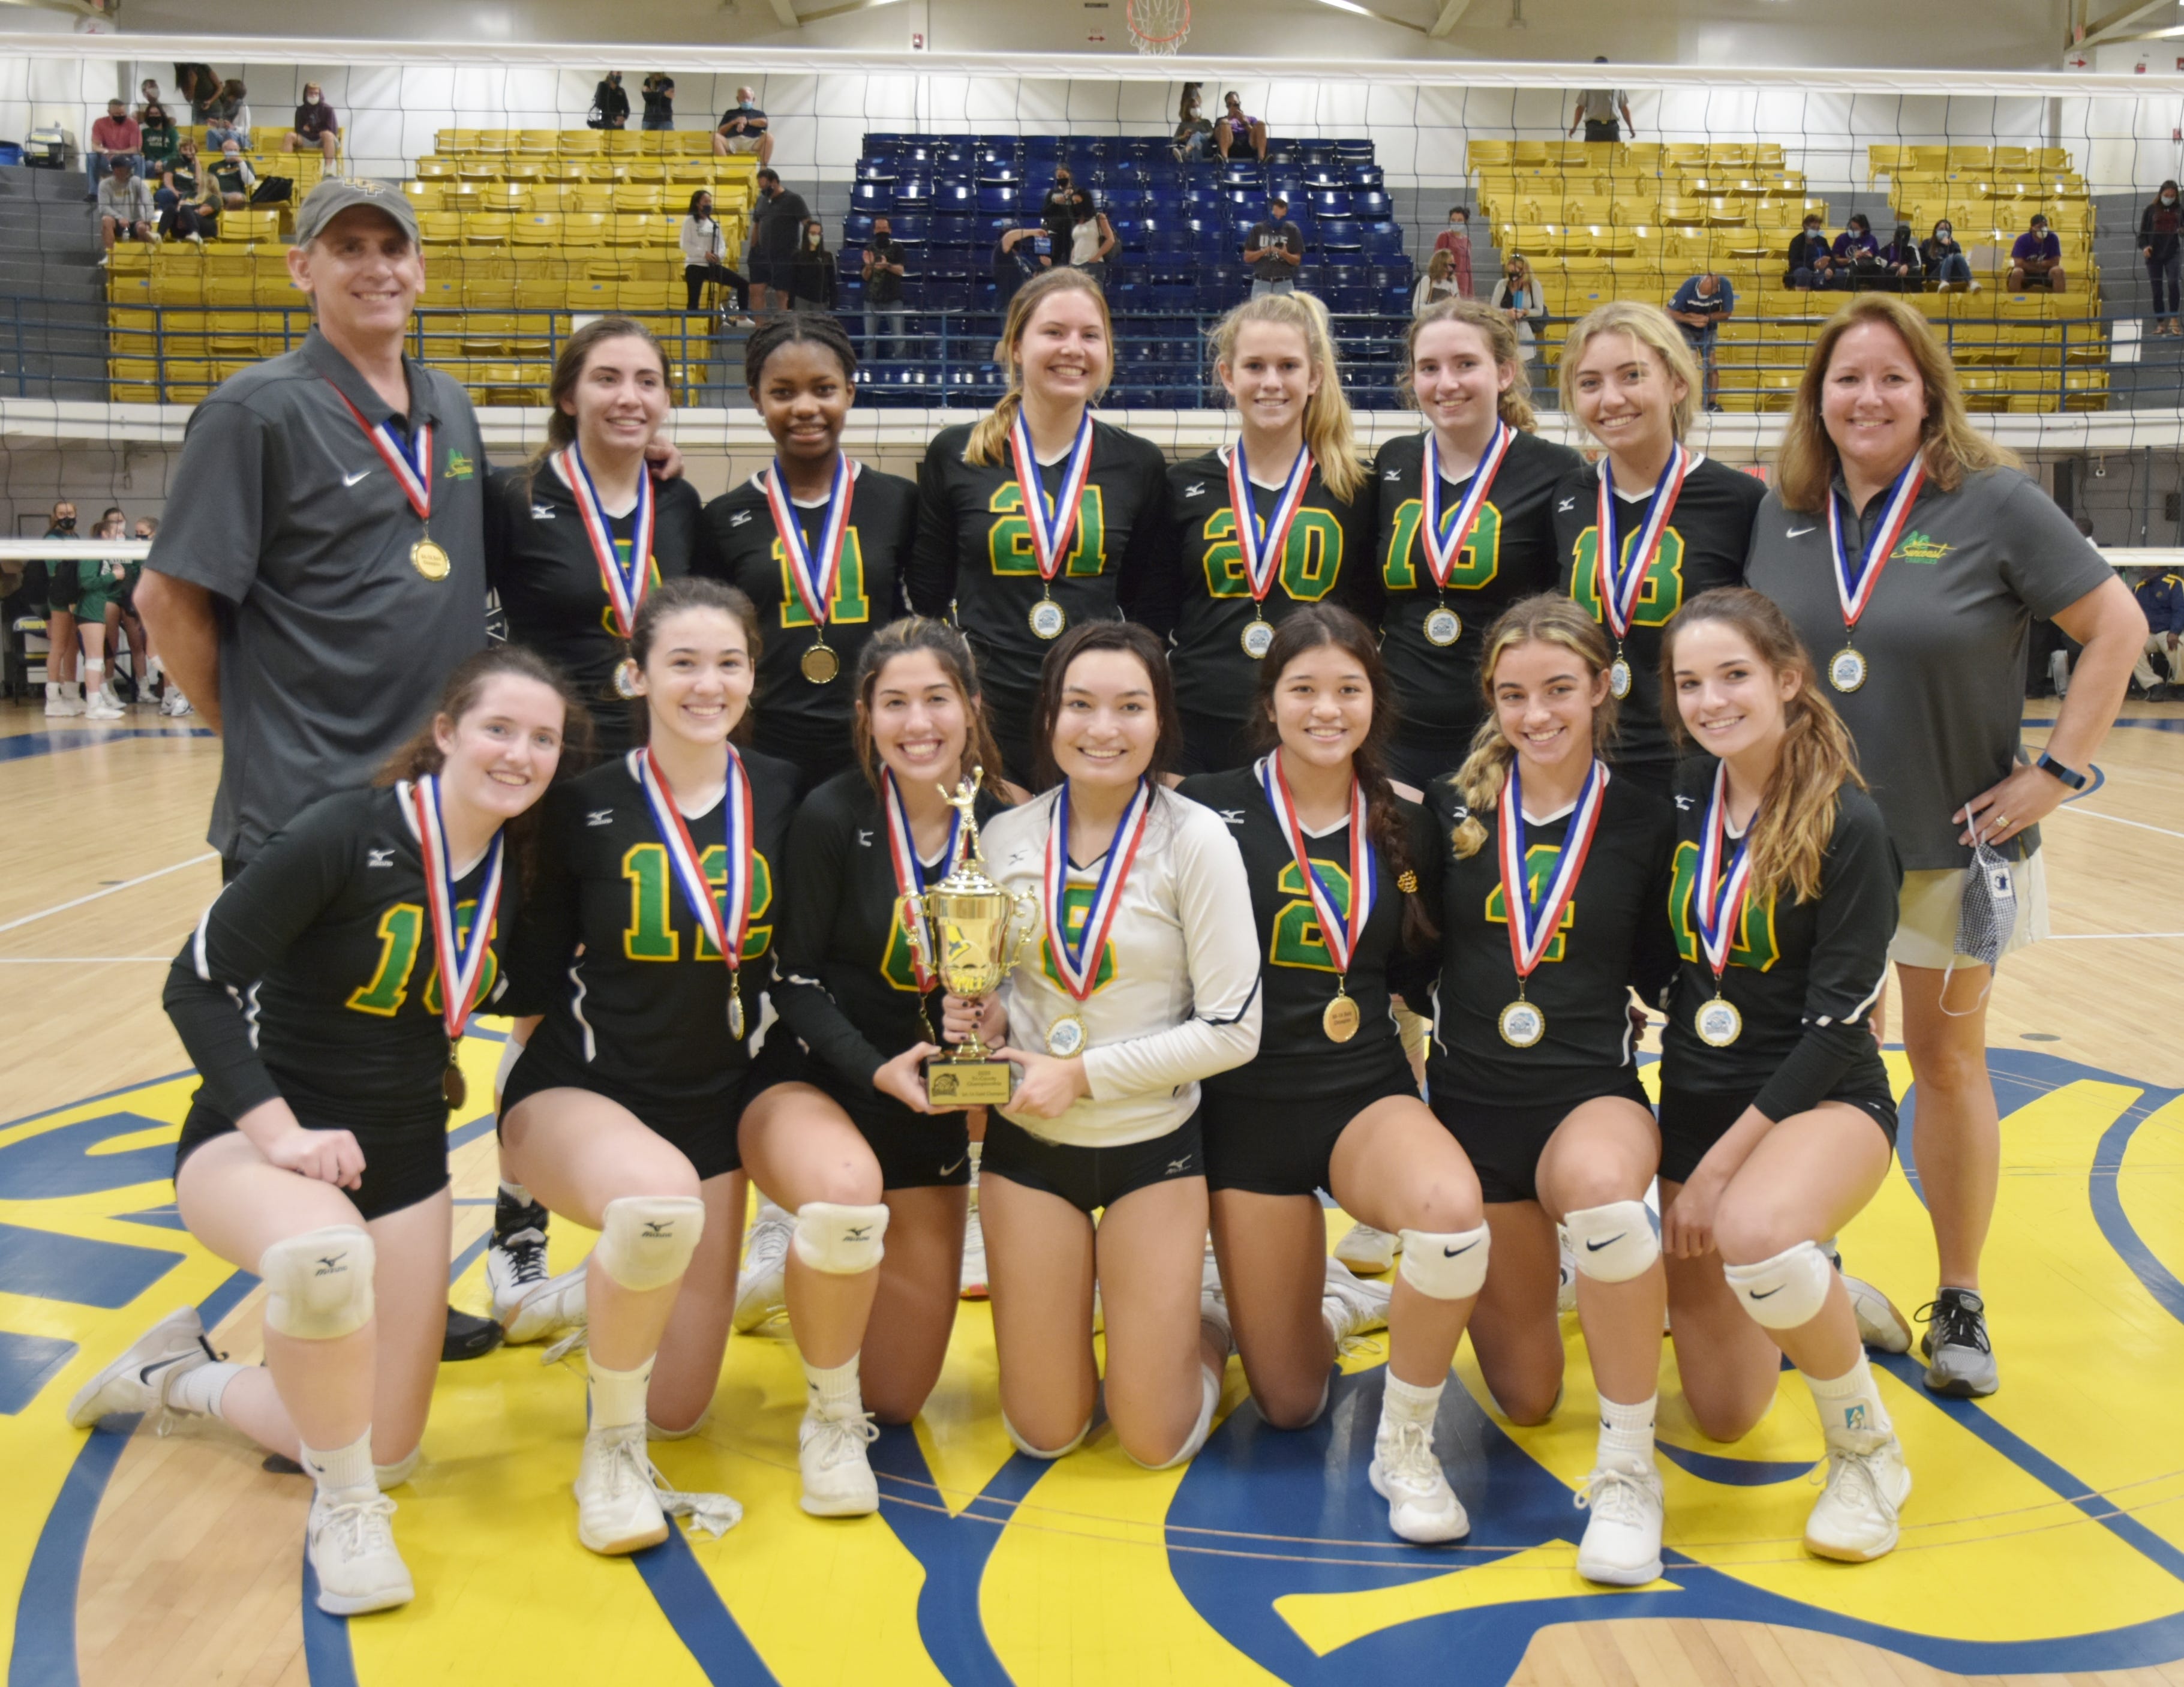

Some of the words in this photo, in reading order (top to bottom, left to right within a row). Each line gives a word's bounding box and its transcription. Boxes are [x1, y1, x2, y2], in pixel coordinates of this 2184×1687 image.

[771, 526, 870, 629] 11
[987, 479, 1107, 577] 21
[1202, 507, 1344, 602] 20
[1383, 498, 1502, 590] 19
[1570, 524, 1684, 626] 18
[622, 842, 773, 962] 12
[1269, 857, 1352, 974] 2
[1485, 844, 1575, 962] 4
[1668, 840, 1780, 973] 10
